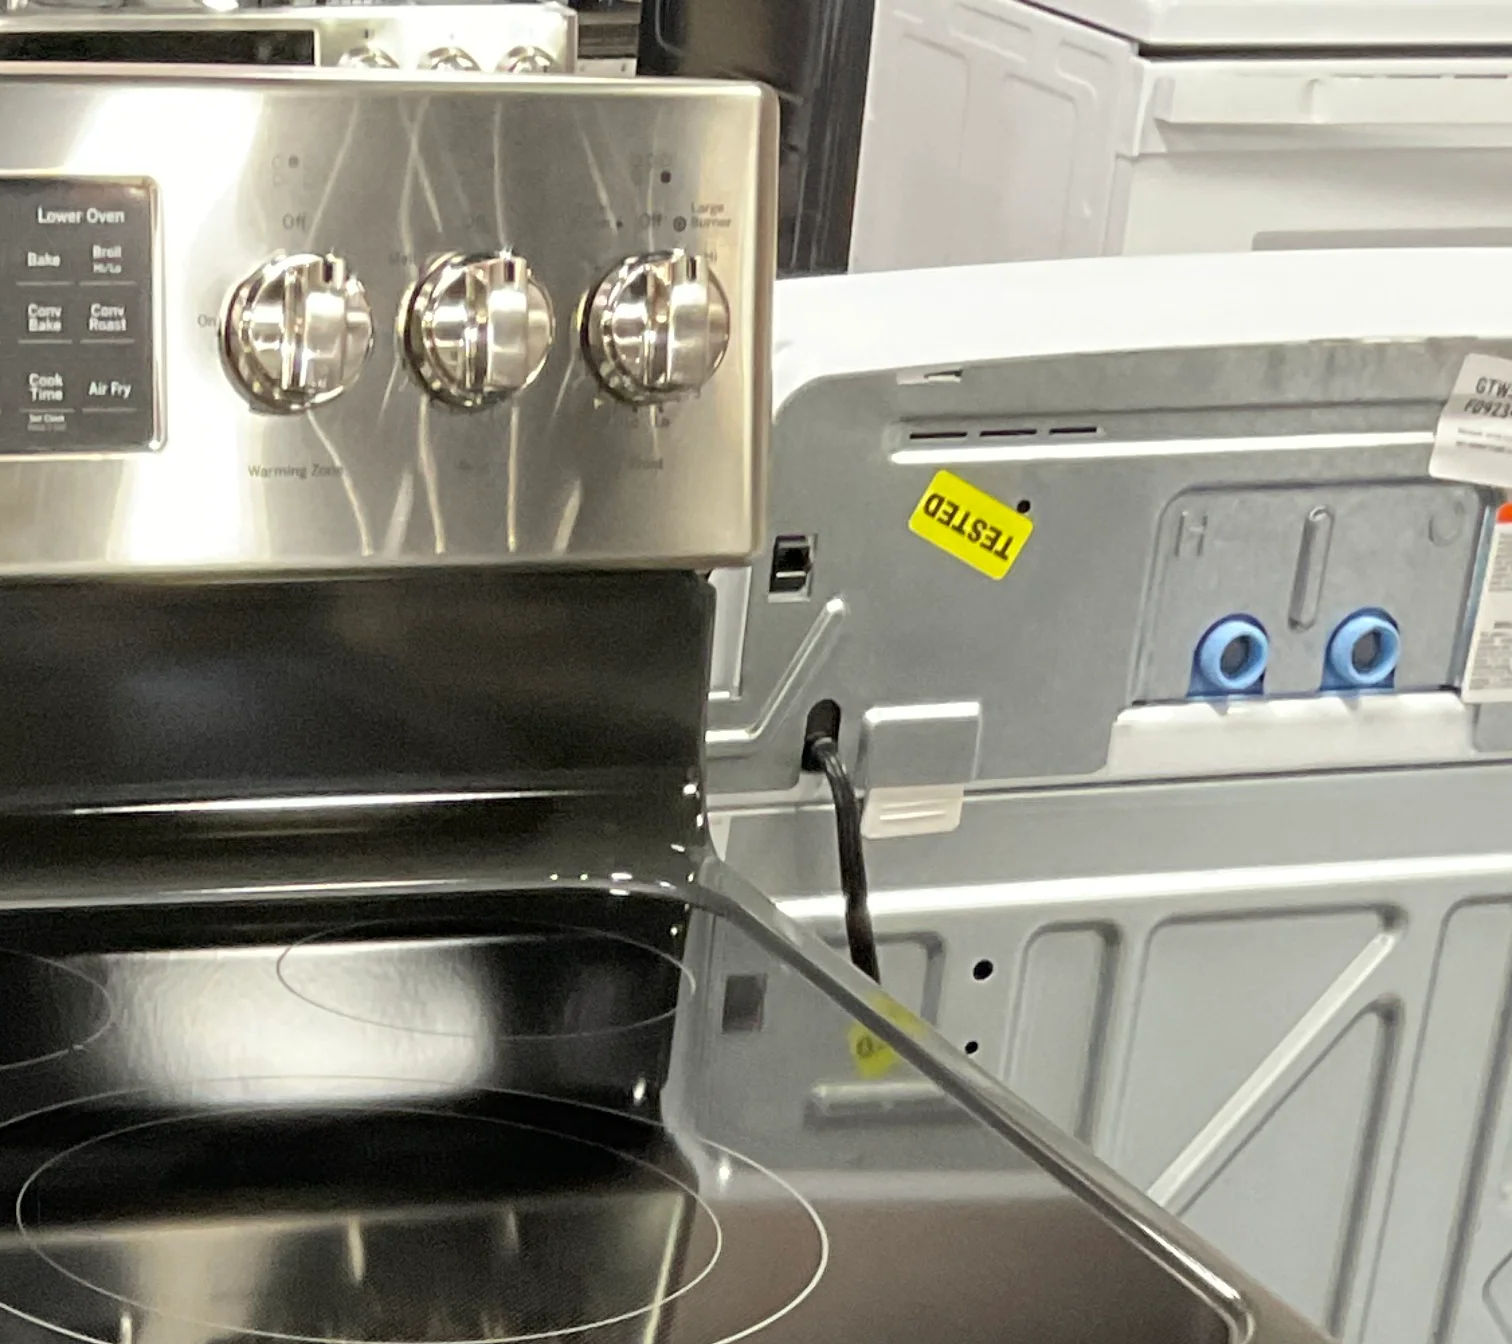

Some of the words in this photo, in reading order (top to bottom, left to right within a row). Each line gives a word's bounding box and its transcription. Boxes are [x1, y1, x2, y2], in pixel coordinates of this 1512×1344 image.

[38, 205, 83, 224] Lower
[87, 208, 125, 224] Oven
[282, 214, 307, 230] Off
[27, 251, 61, 267] Bake
[92, 244, 122, 259] Broil
[27, 303, 62, 318] Conv
[90, 303, 125, 317] Conv
[28, 318, 62, 333] Bake
[89, 317, 127, 332] Roast
[197, 313, 216, 327] On
[29, 372, 63, 388] Cook
[29, 387, 64, 401] Time
[88, 381, 108, 396] Air
[110, 380, 132, 399] Fry
[248, 463, 306, 479] Warming
[923, 492, 1014, 562] TESTED
